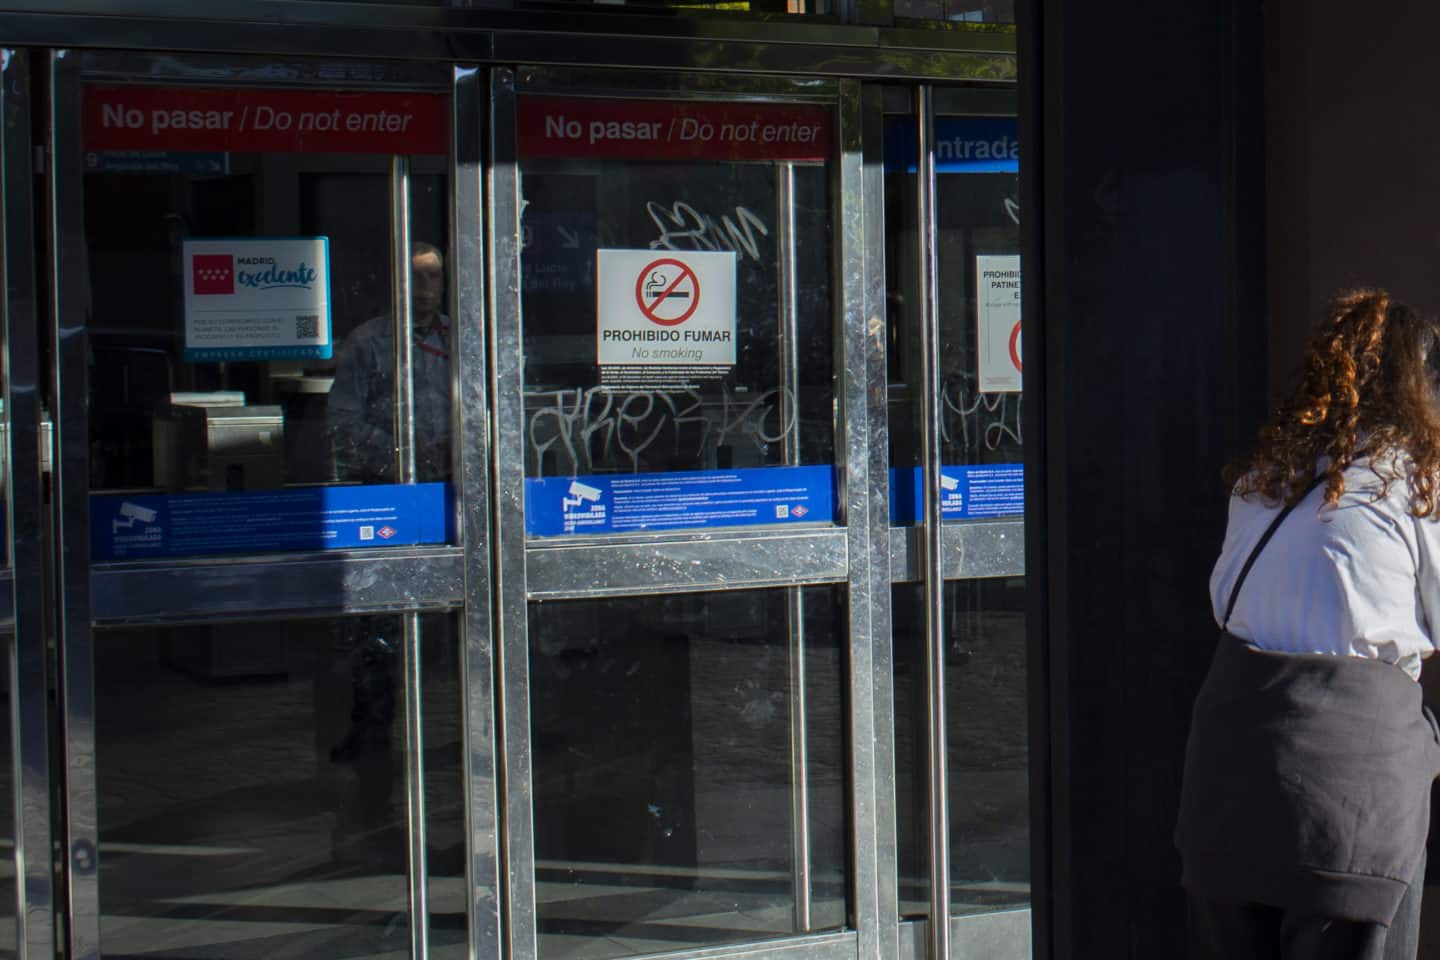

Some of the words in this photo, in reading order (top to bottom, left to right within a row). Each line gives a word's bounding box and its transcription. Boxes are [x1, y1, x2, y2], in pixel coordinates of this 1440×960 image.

[102, 103, 145, 129] No
[151, 109, 234, 135] pasar
[254, 105, 293, 131] Do
[299, 107, 341, 132] not
[346, 110, 413, 133] enter
[545, 115, 583, 139] No
[589, 119, 662, 144] pasar
[679, 117, 715, 141] Do
[720, 120, 762, 142] not
[762, 122, 821, 143] enter
[936, 135, 1019, 160] ntrada
[237, 257, 275, 265] MADRID
[603, 330, 680, 342] PROHIBIDO
[684, 330, 731, 342] FUMAR
[631, 347, 649, 359] No
[652, 347, 704, 361] smoking
